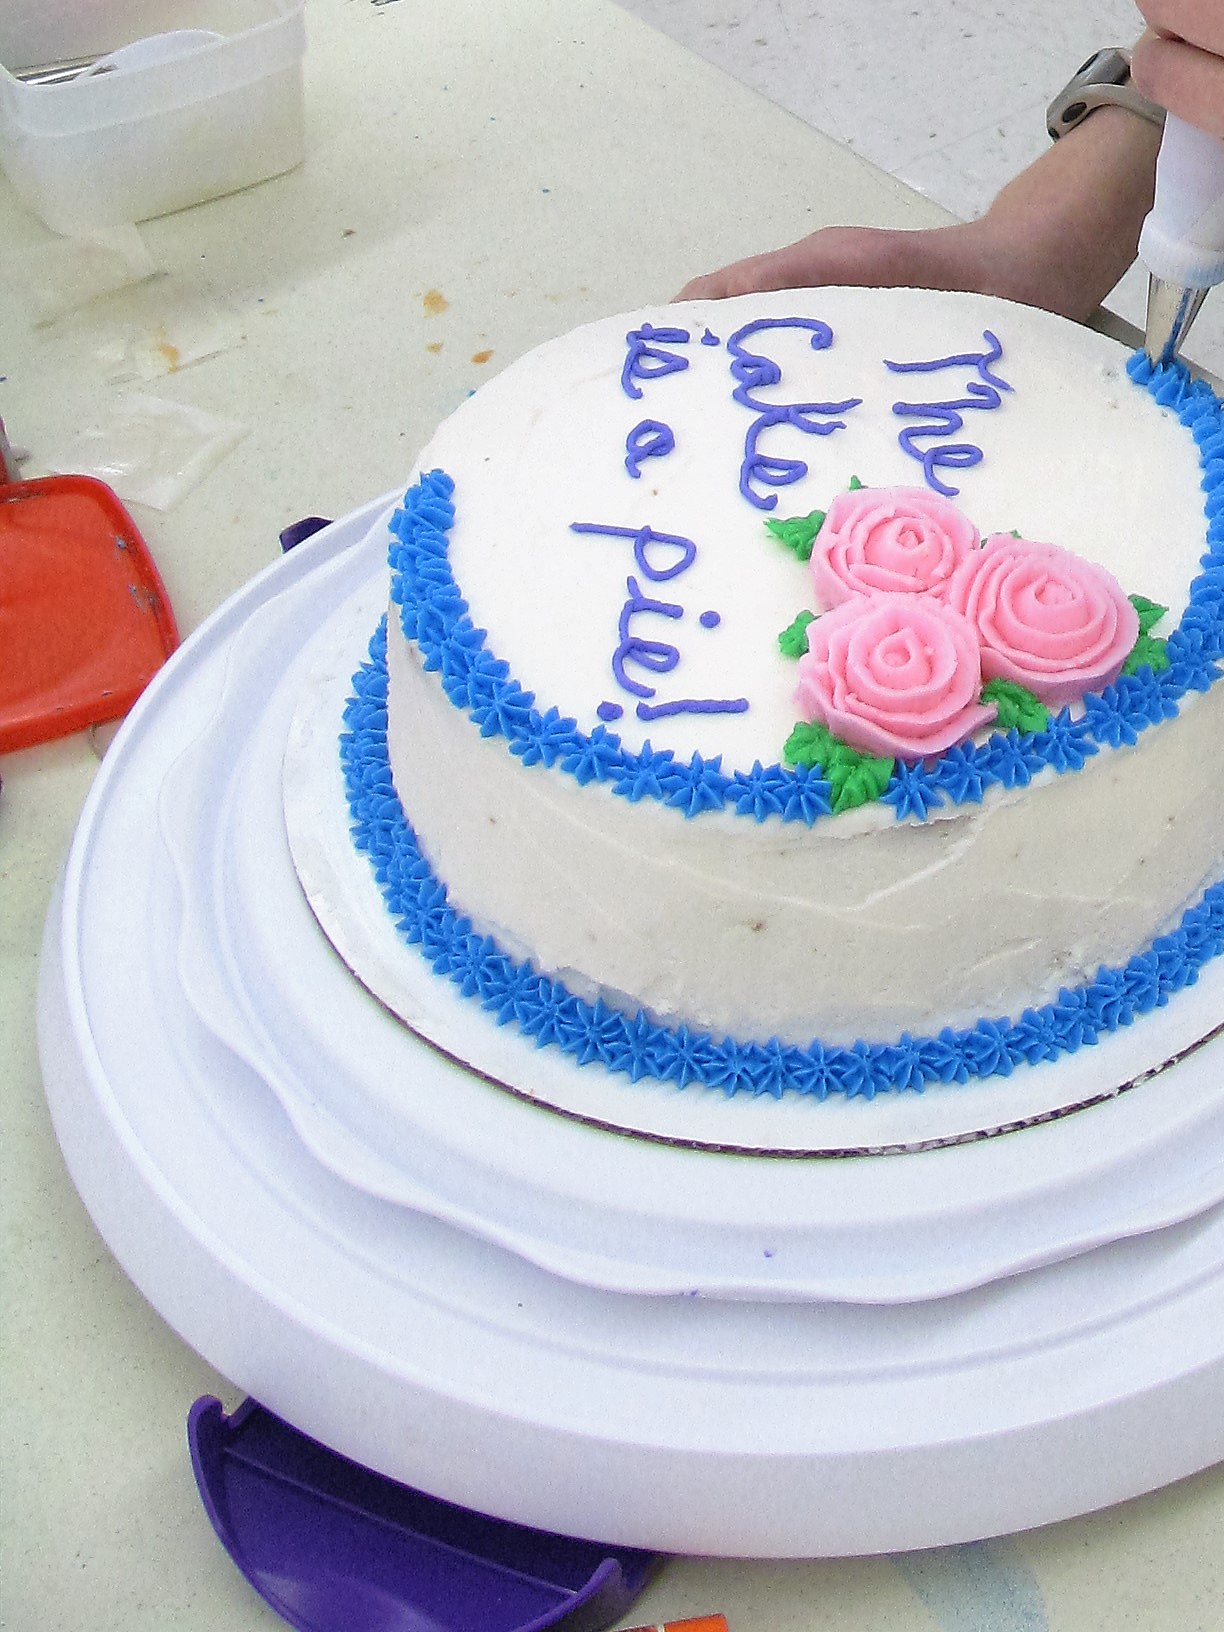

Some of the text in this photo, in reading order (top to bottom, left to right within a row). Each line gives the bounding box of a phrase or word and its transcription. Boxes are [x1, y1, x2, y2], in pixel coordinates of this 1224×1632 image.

[727, 317, 863, 511] Cake
[883, 330, 1016, 497] The
[568, 323, 749, 722] is a pie!
